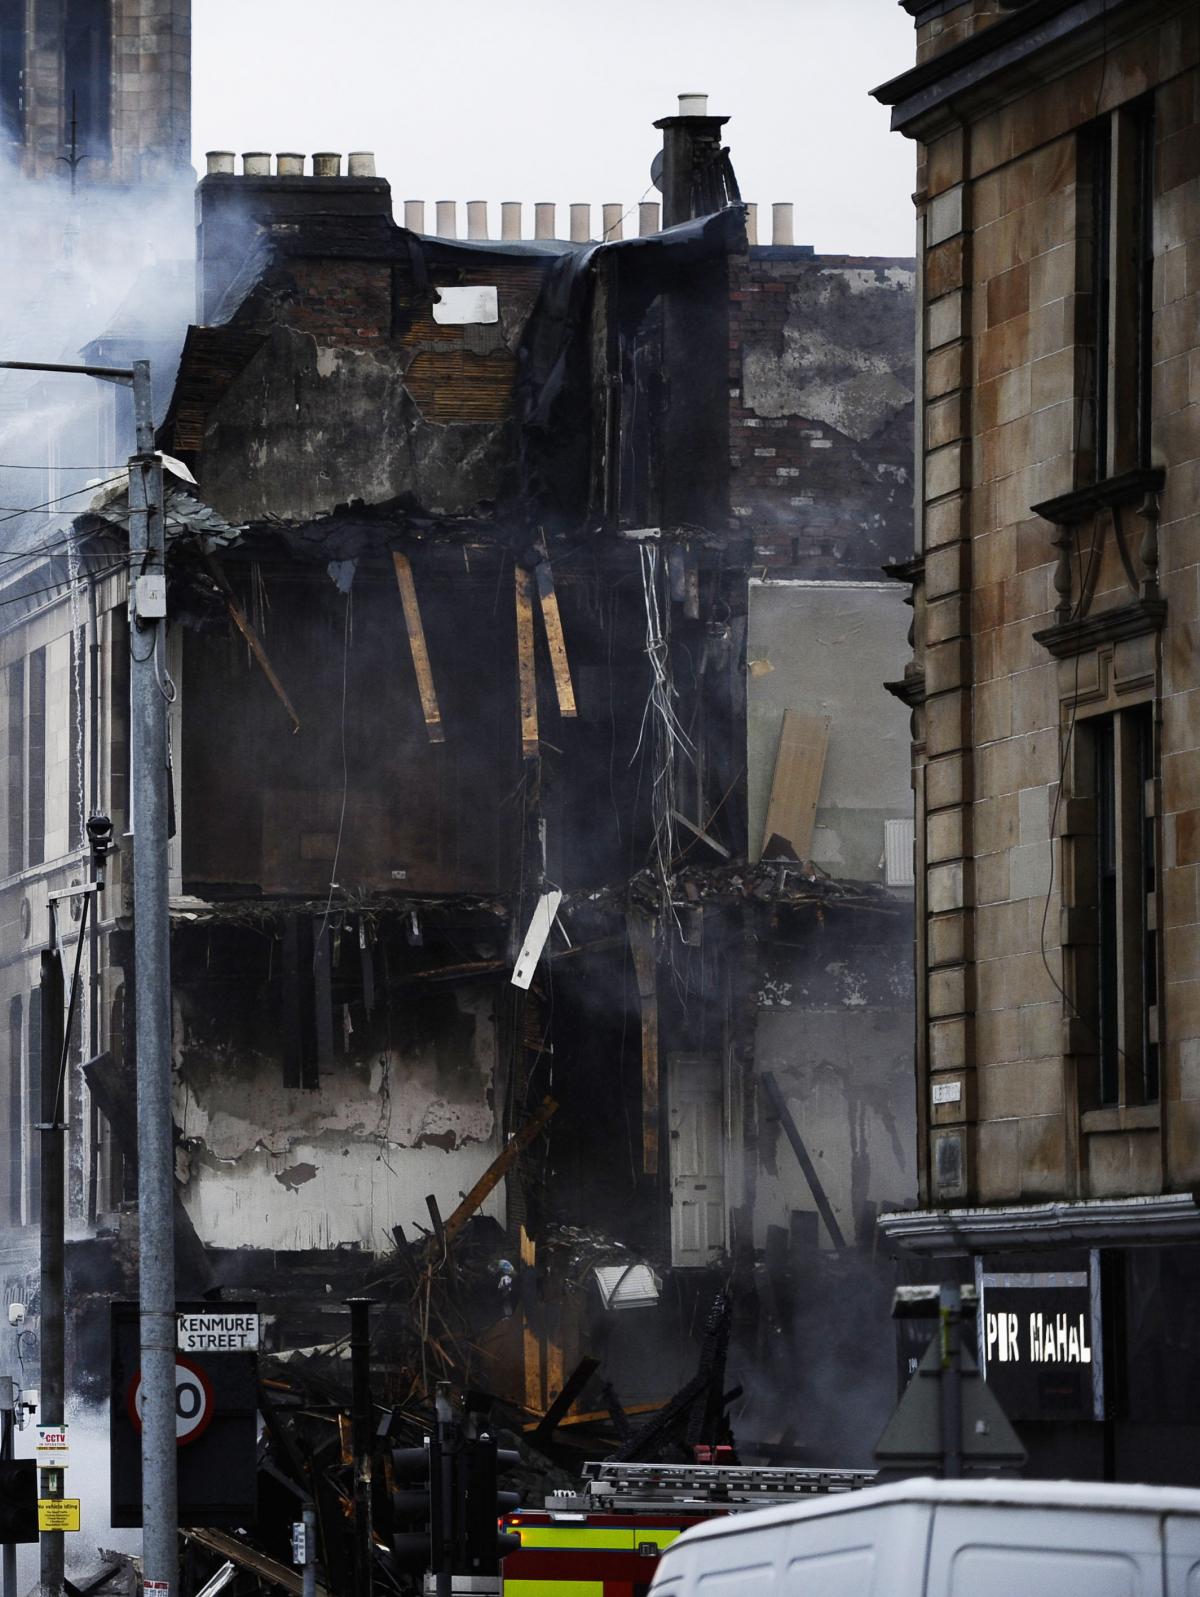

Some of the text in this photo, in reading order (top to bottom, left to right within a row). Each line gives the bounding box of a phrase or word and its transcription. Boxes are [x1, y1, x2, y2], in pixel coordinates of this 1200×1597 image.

[180, 1318, 255, 1331] KENMURE
[187, 1334, 247, 1348] STREET
[176, 1382, 201, 1419] 0
[45, 1434, 66, 1442] CCTV
